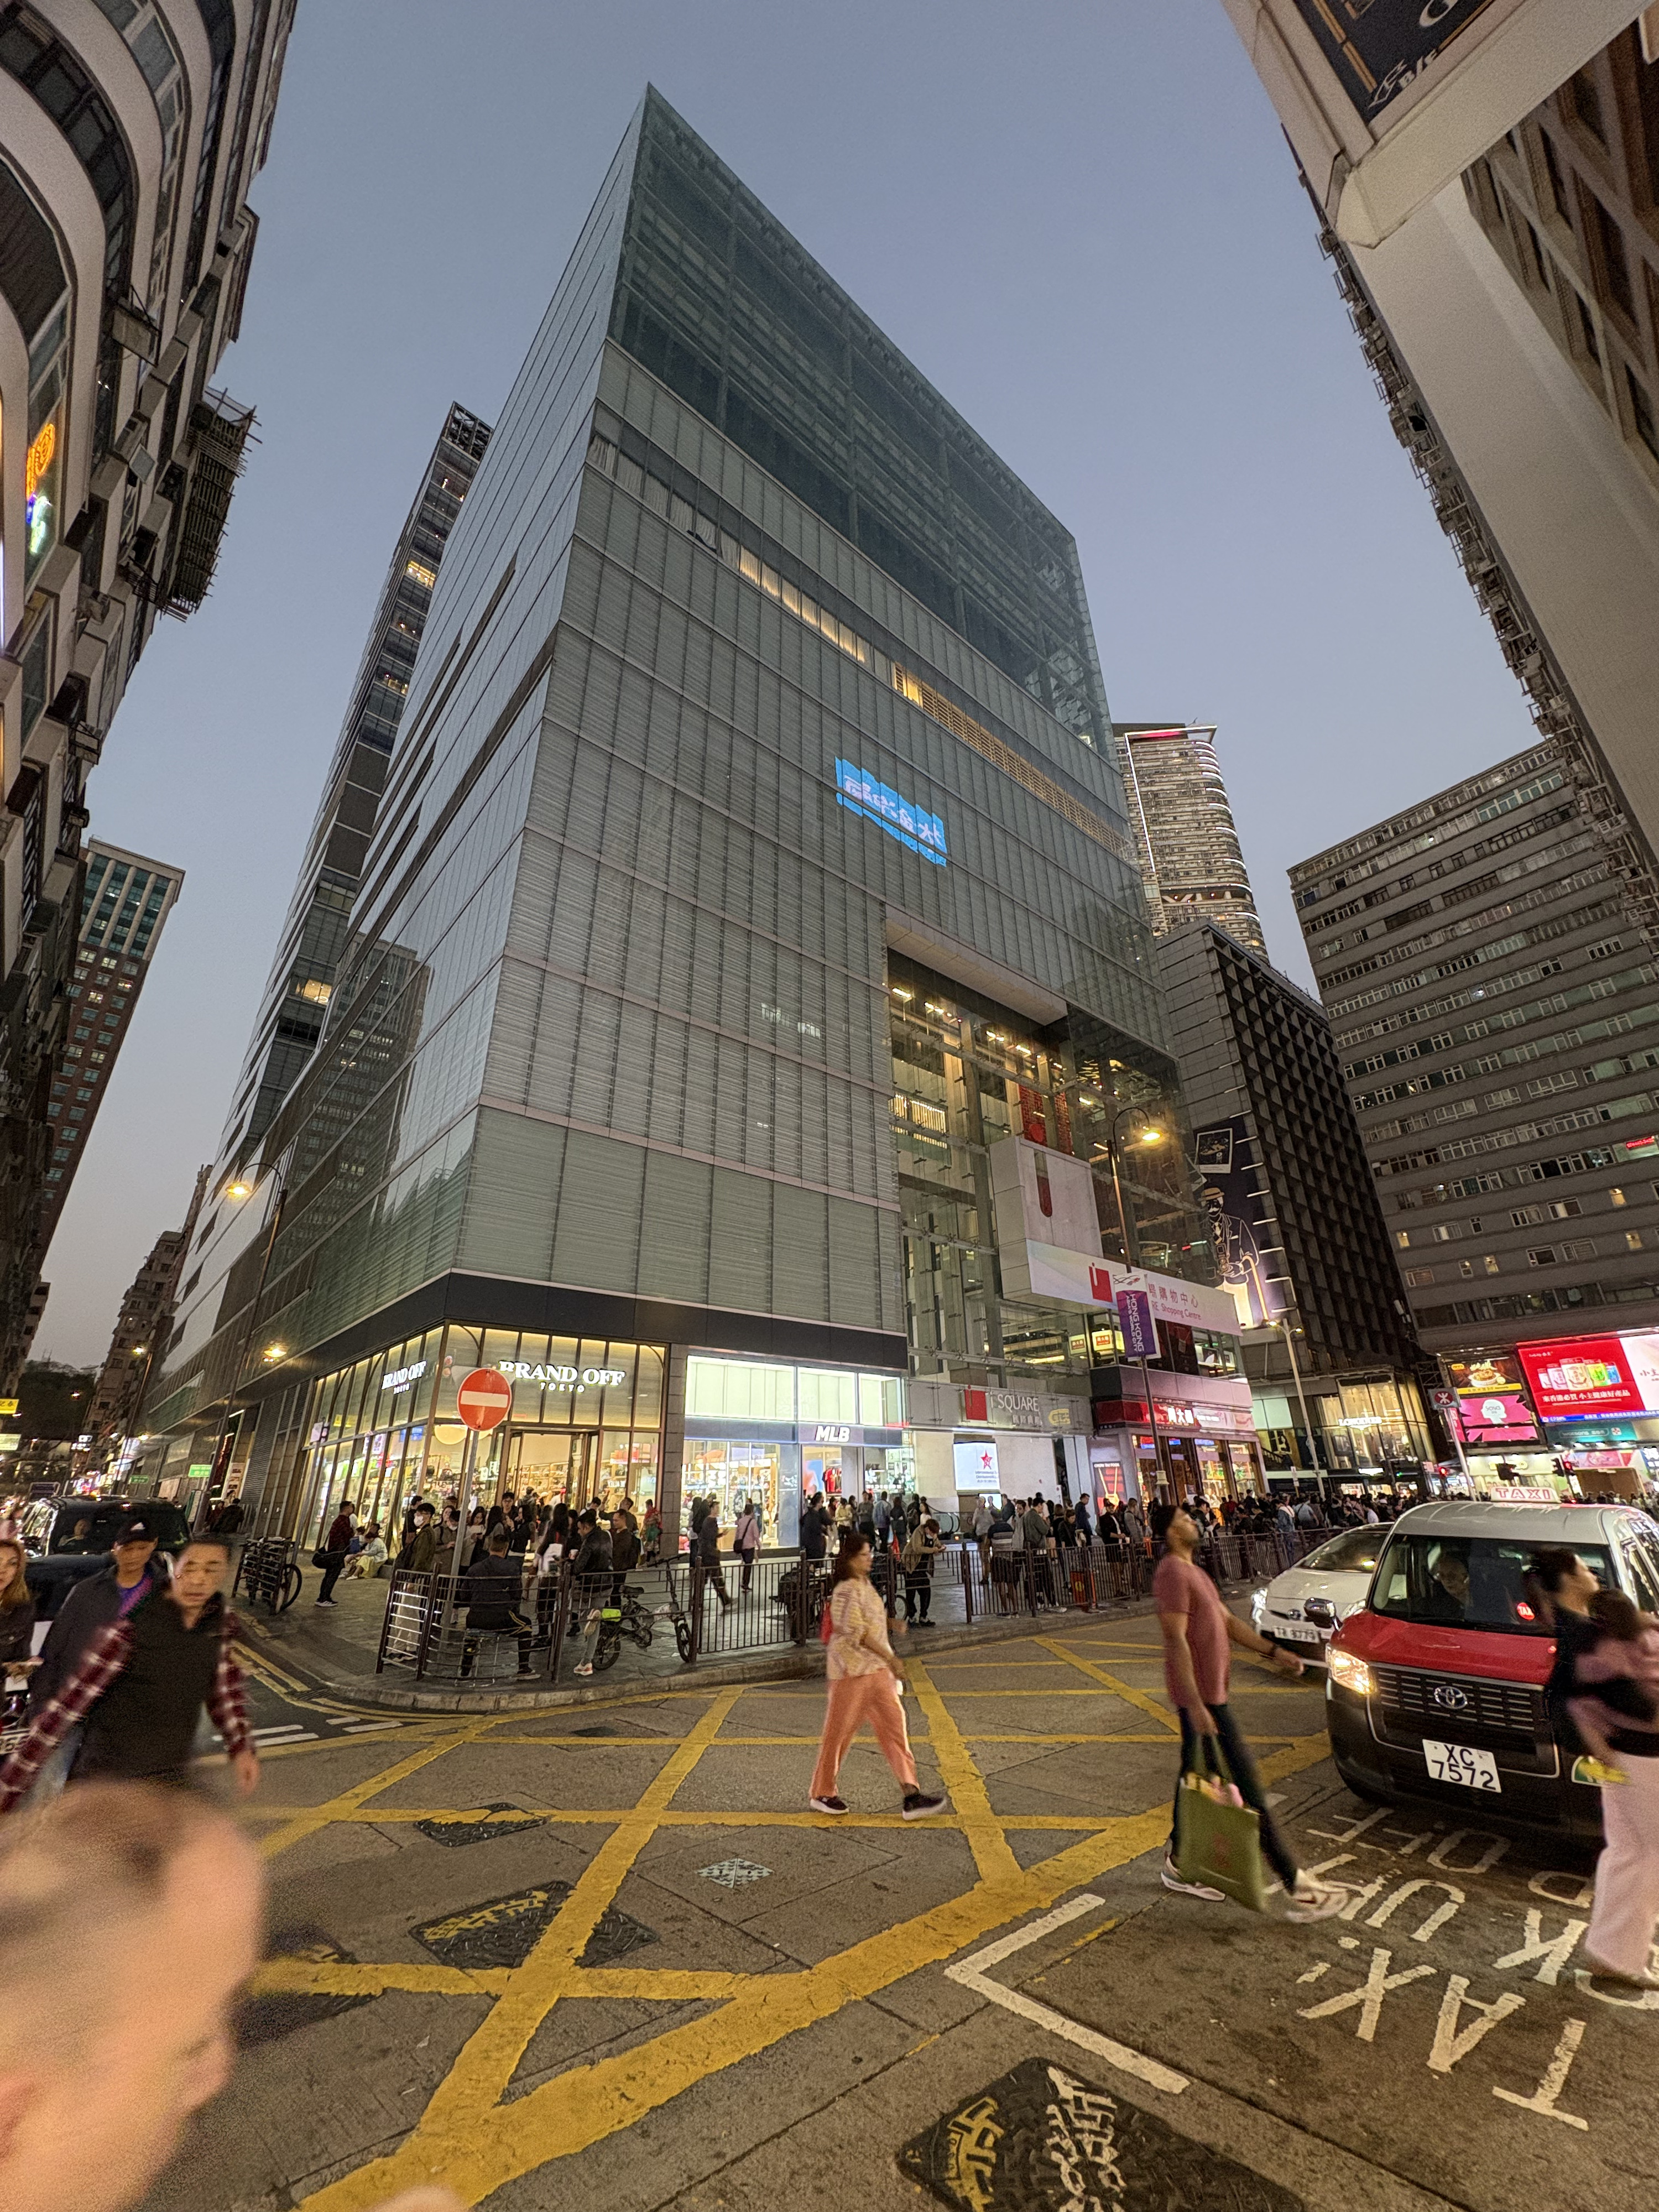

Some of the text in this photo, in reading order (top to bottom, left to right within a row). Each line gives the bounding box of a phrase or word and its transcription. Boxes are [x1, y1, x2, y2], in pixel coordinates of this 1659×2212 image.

[1161, 1303, 1184, 1319] Shopping
[1185, 1311, 1202, 1321] Centre
[1130, 1293, 1145, 1352] HONG KONG
[382, 1360, 427, 1390] BRAND OFF
[499, 1360, 625, 1386] BRAND OFF
[540, 1382, 585, 1393] TOKYO
[998, 1394, 1040, 1412] SQUARE
[816, 1425, 850, 1442] MLB
[1495, 1488, 1551, 1500] TAXI
[1444, 1744, 1474, 1766] XC
[1431, 1759, 1496, 1791] 7572
